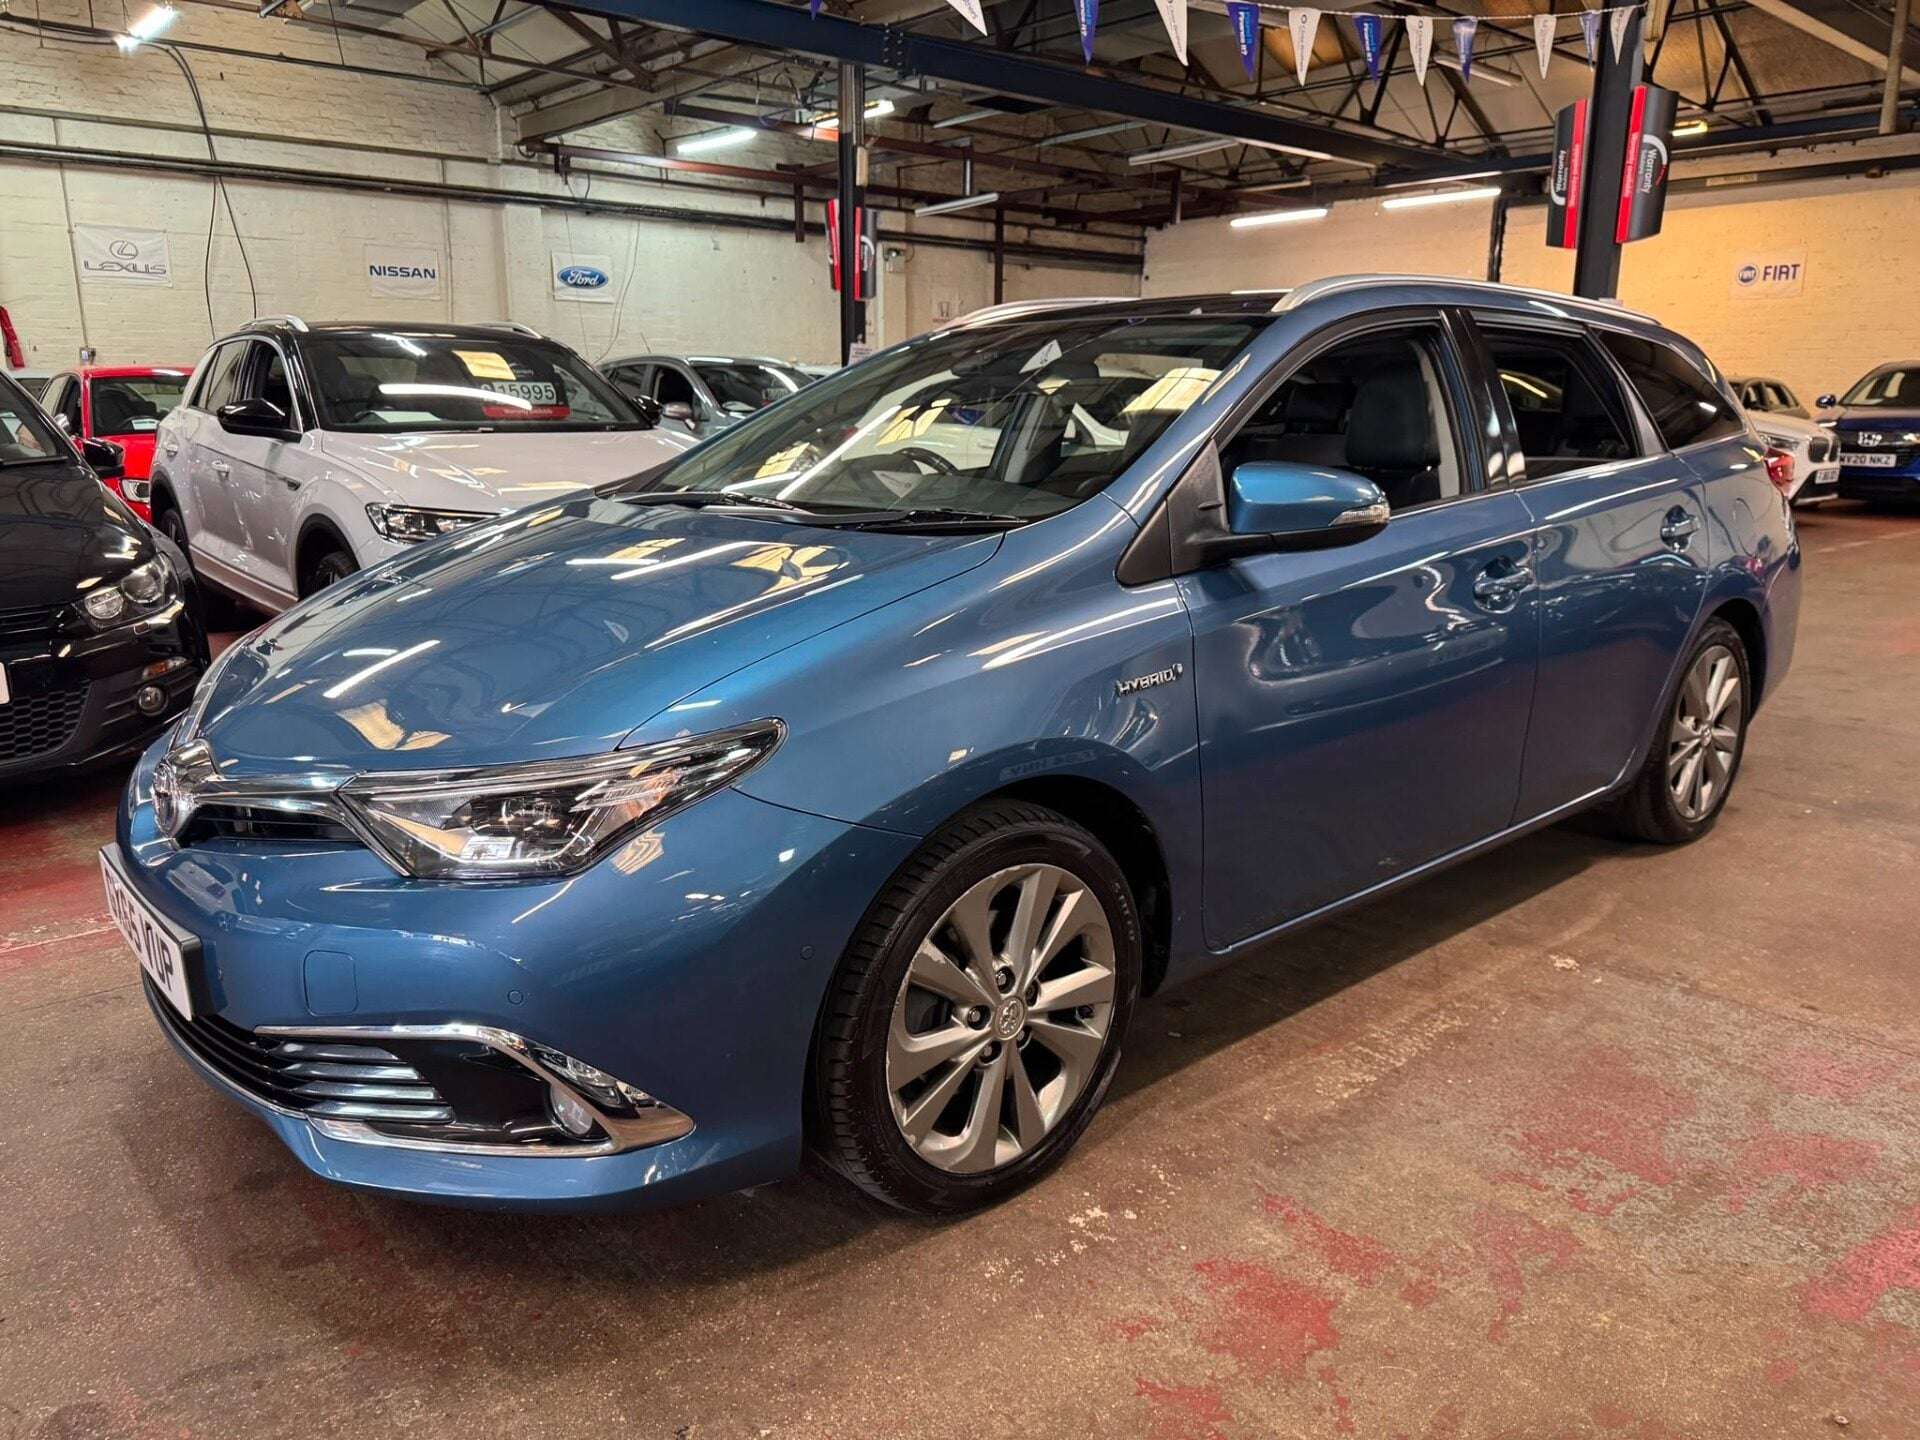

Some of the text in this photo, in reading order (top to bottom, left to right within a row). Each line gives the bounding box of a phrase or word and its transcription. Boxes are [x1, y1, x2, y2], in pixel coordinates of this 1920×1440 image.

[1556, 150, 1566, 192] Warranty
[1641, 148, 1657, 193] Warranty
[84, 260, 167, 275] LEXUS
[369, 264, 436, 279] NISSAN
[1762, 263, 1801, 281] FIAT
[567, 269, 600, 287] Ford
[1117, 669, 1174, 692] HYBRID
[139, 912, 174, 993] VUP
